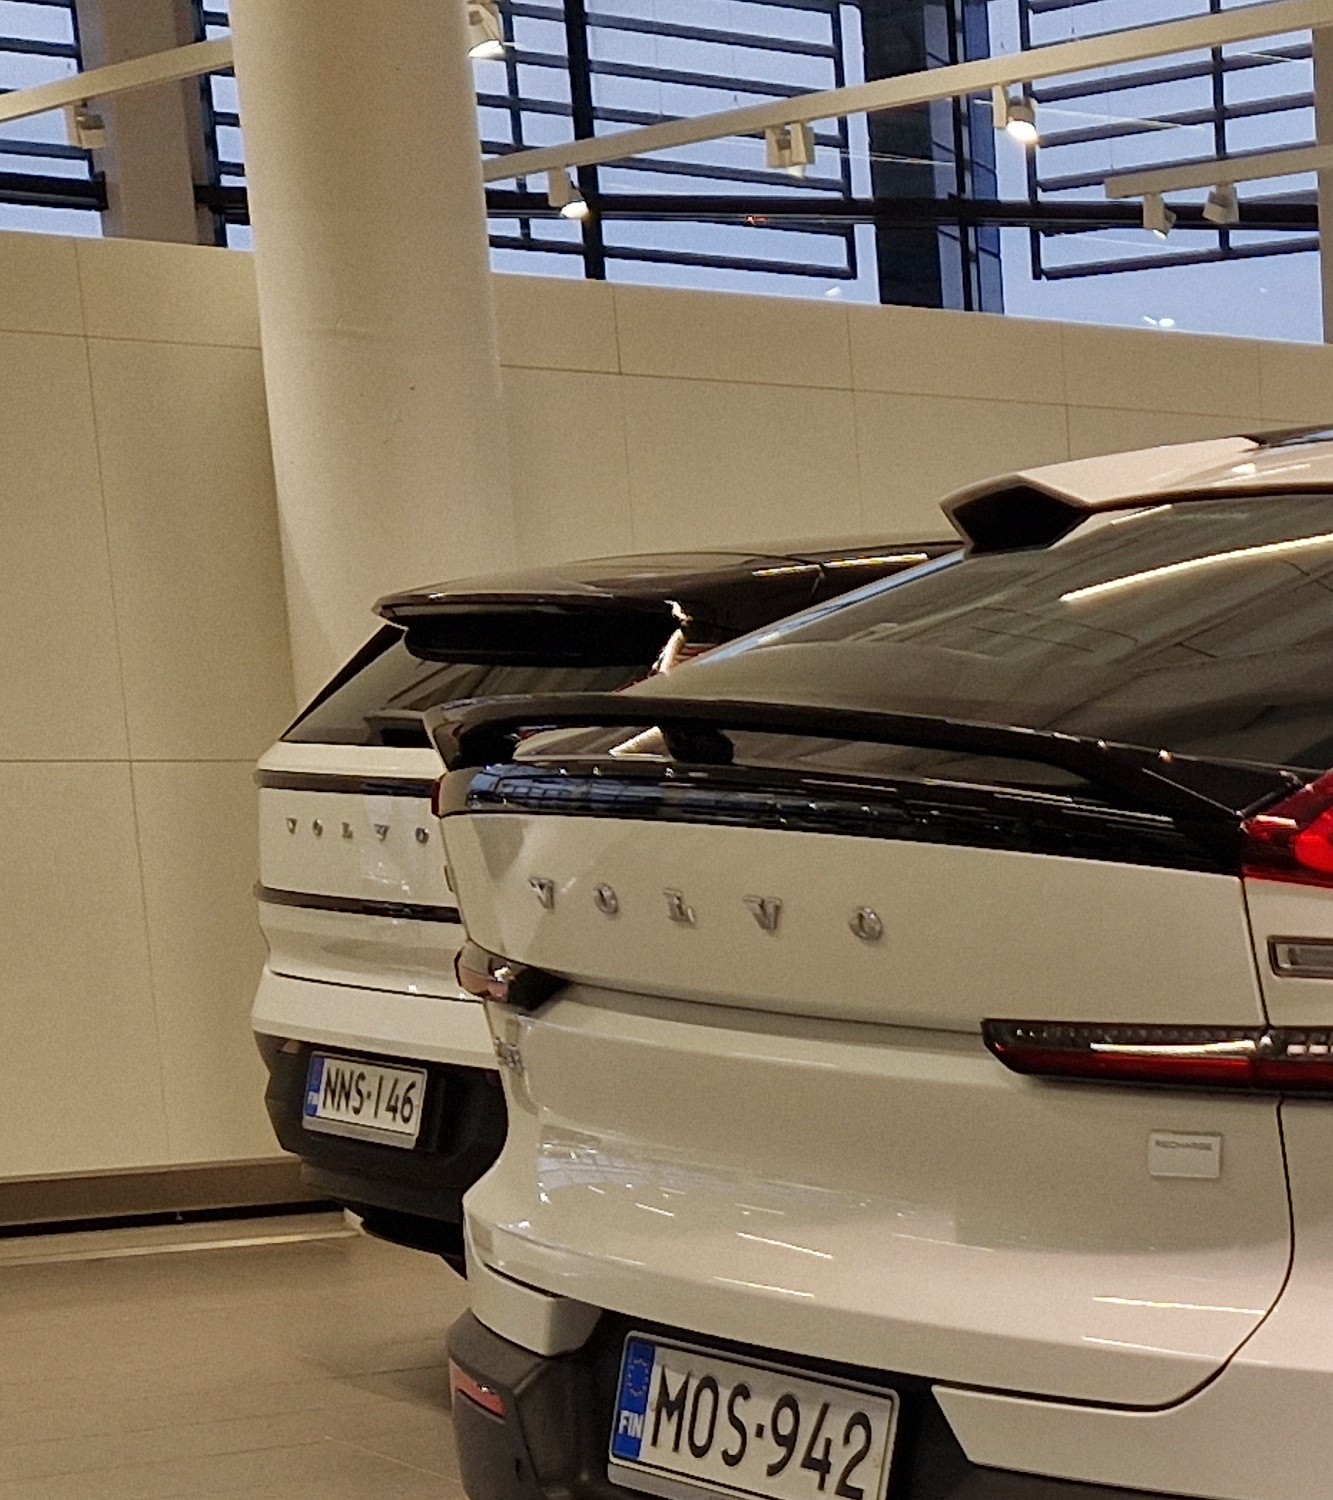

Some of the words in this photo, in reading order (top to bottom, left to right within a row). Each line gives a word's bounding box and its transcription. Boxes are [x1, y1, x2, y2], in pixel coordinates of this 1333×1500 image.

[285, 817, 430, 845] VOLVO
[529, 877, 885, 943] VOLVO
[618, 1410, 645, 1439] FIN
